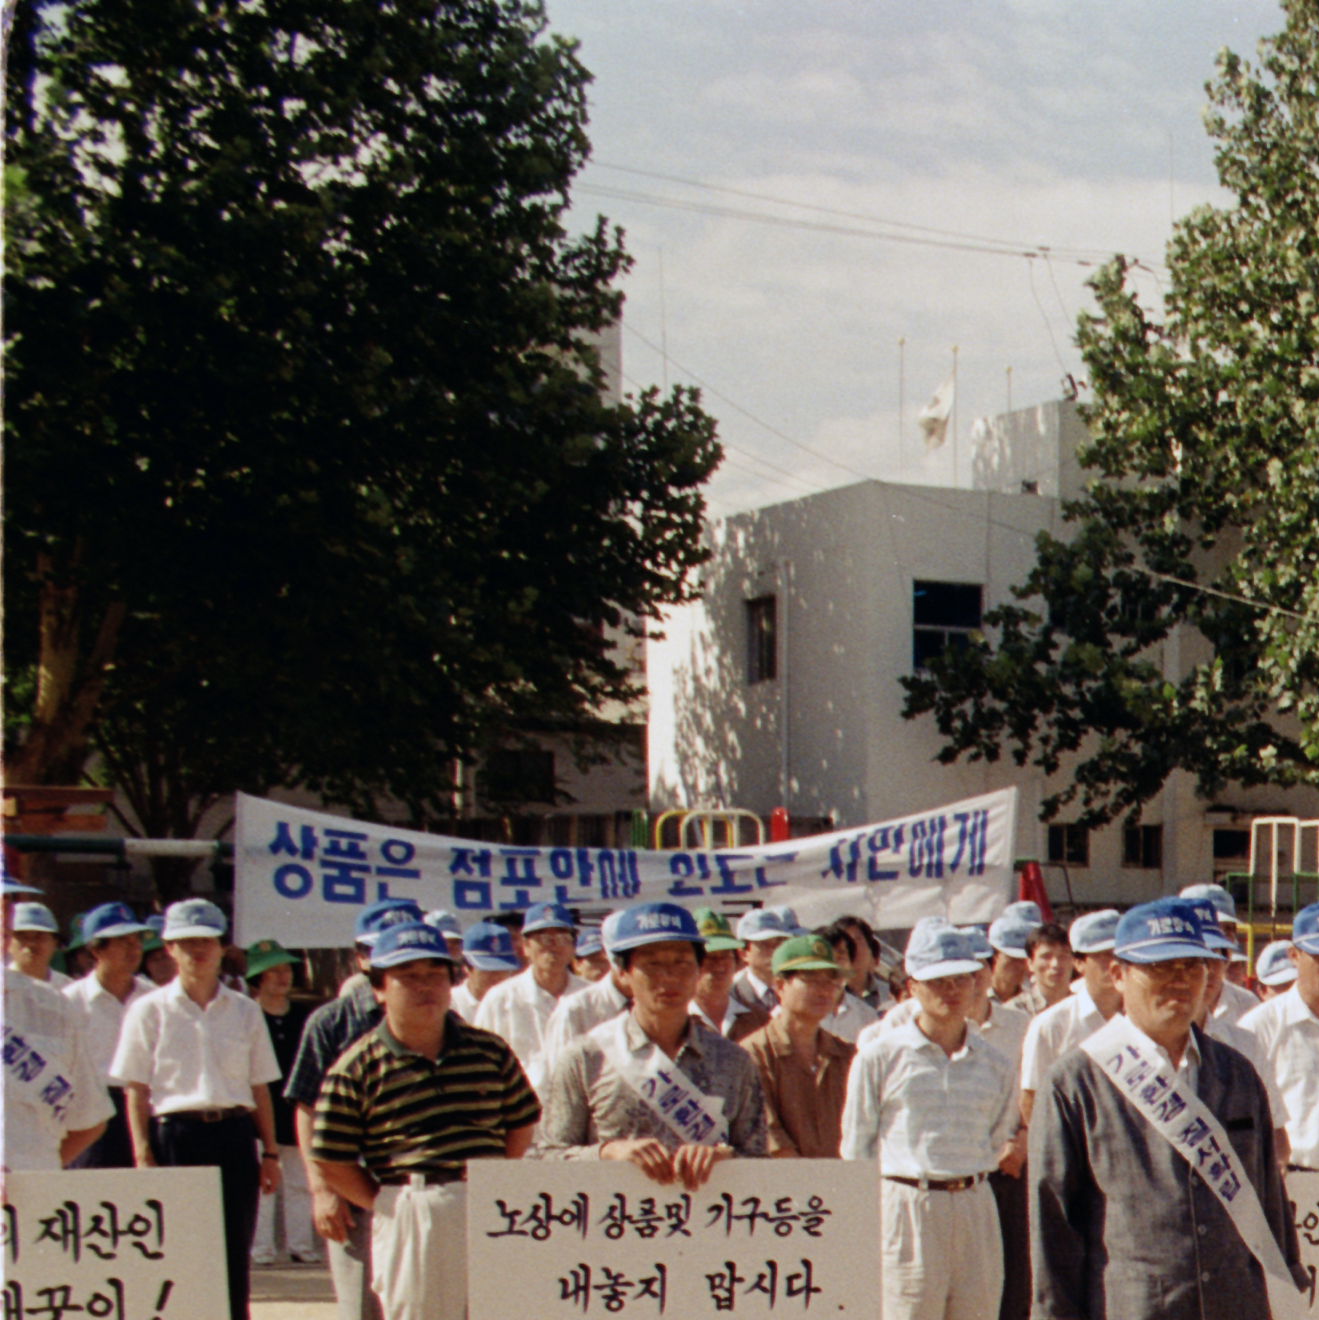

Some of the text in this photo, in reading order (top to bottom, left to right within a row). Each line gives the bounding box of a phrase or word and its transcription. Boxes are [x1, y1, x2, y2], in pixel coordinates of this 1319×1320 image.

[268, 821, 421, 904] 상품은
[449, 846, 641, 911] 점포안에
[821, 808, 989, 883] 시민에게
[34, 1199, 166, 1265] 재산인
[486, 1191, 589, 1242] 노상에
[599, 1191, 693, 1242] 상품및
[558, 1262, 668, 1315] 내놓지
